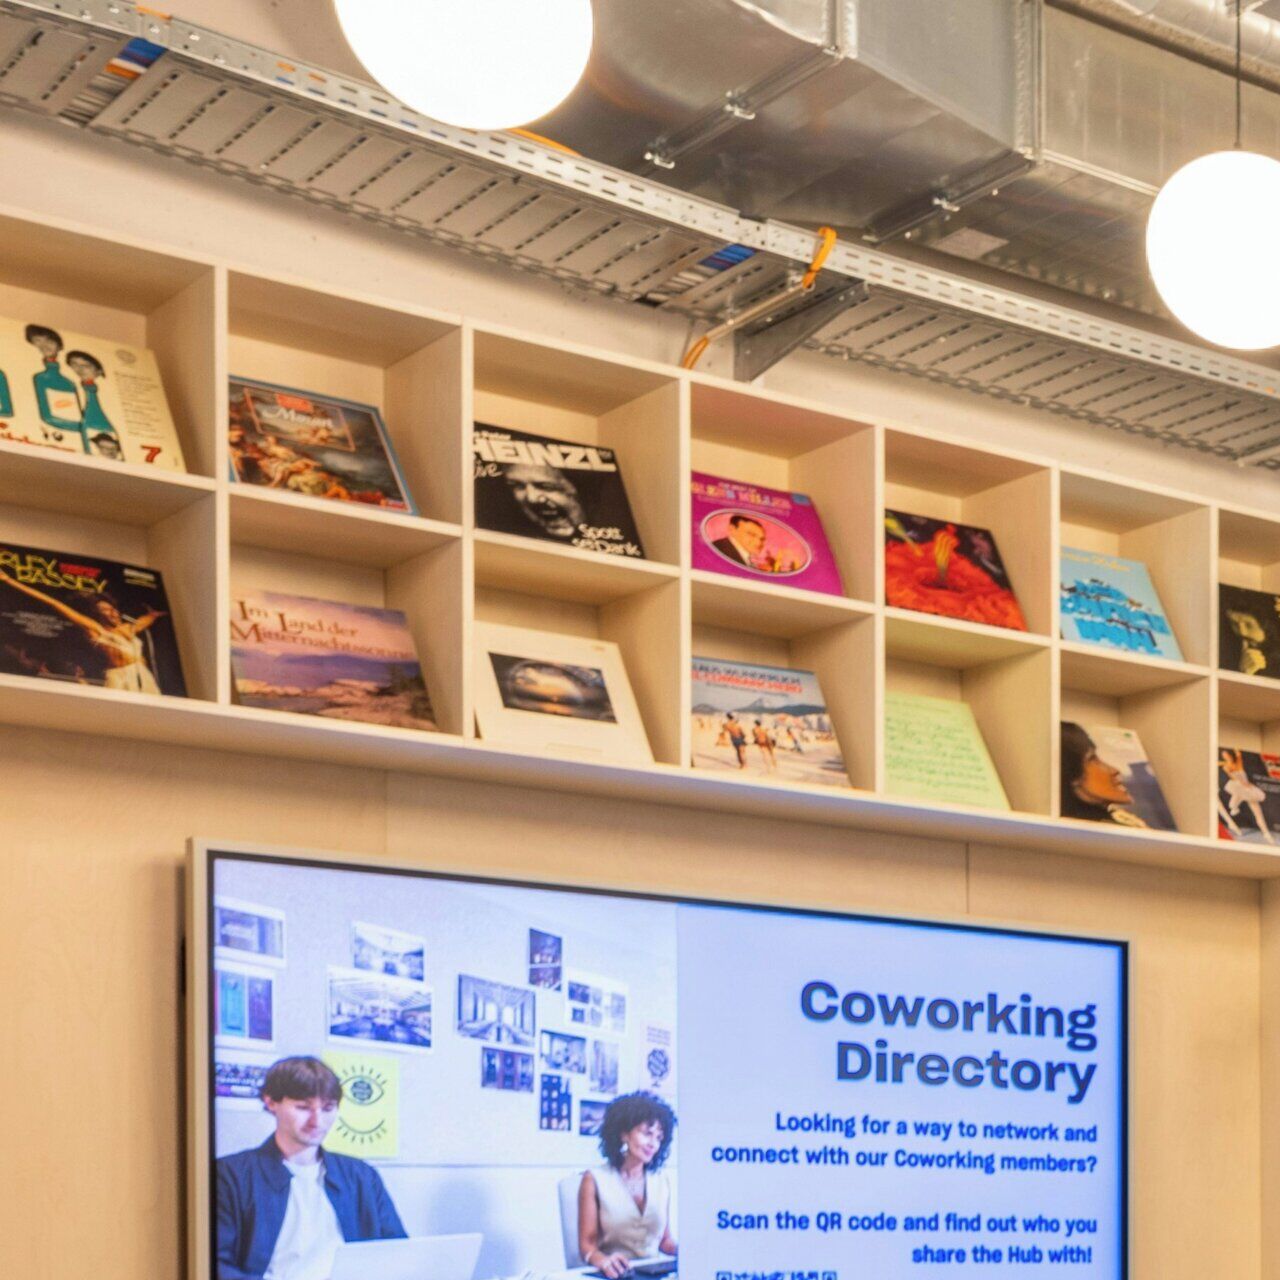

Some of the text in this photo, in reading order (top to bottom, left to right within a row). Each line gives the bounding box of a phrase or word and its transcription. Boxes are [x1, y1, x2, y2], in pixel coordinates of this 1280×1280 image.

[800, 980, 1098, 1051] Coworking
[837, 1039, 1097, 1104] Directory
[775, 1112, 1098, 1142] Looking for a way to network and
[711, 1145, 1098, 1175] connect with our Coworking members?
[717, 1211, 1098, 1237] Scan the QR code and find out who you
[912, 1243, 1093, 1265] share the Hub with!
